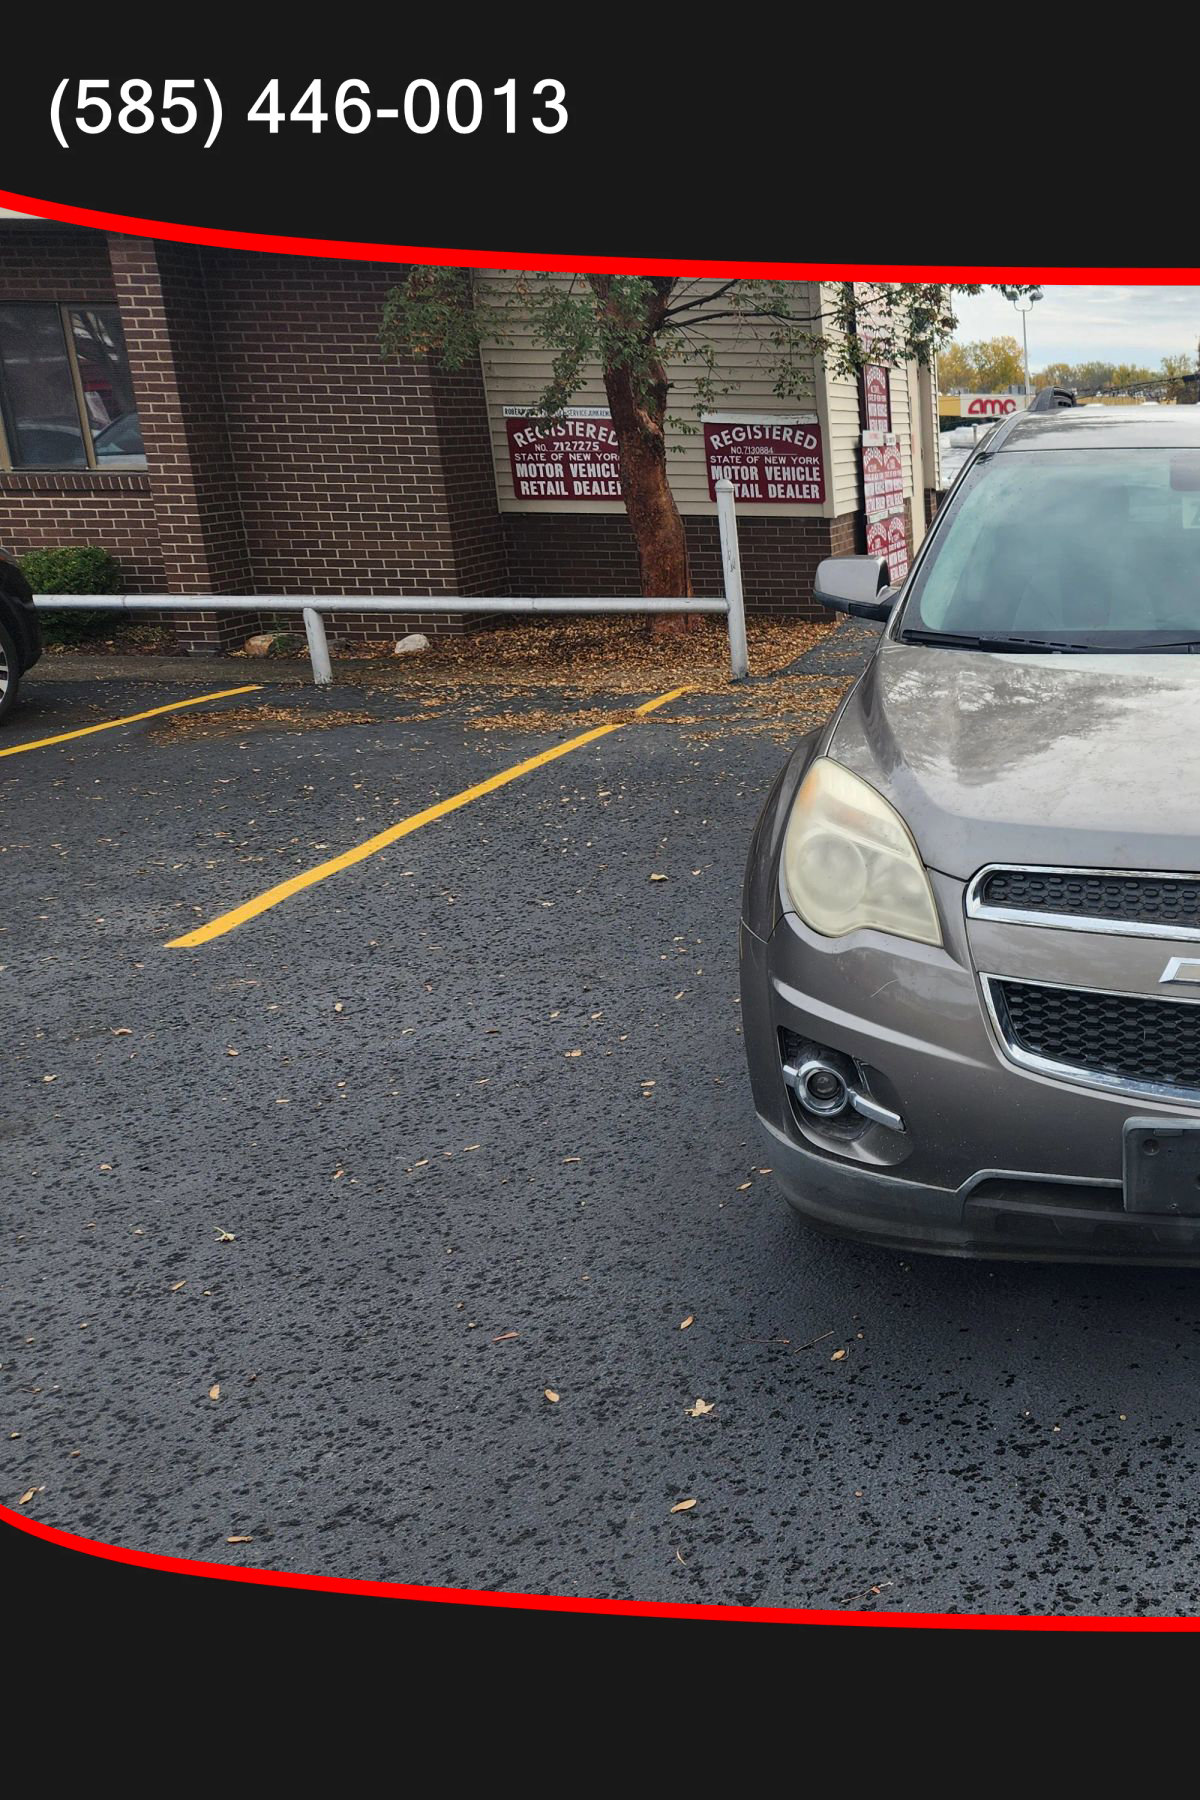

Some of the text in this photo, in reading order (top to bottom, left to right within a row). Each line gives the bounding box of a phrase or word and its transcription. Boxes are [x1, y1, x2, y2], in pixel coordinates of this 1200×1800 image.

[710, 425, 818, 450] REGISTERED
[553, 441, 600, 451] 7127275
[514, 453, 620, 461] STATE OF NEW YOR
[746, 456, 760, 464] OF
[764, 456, 786, 464] NEW
[791, 456, 820, 464] YORK
[515, 463, 620, 478] MOTOR VEHICL
[711, 465, 821, 481] MOTOR VEHICLE
[520, 481, 568, 496] RETAIL
[733, 483, 820, 499] TAIL DEALER
